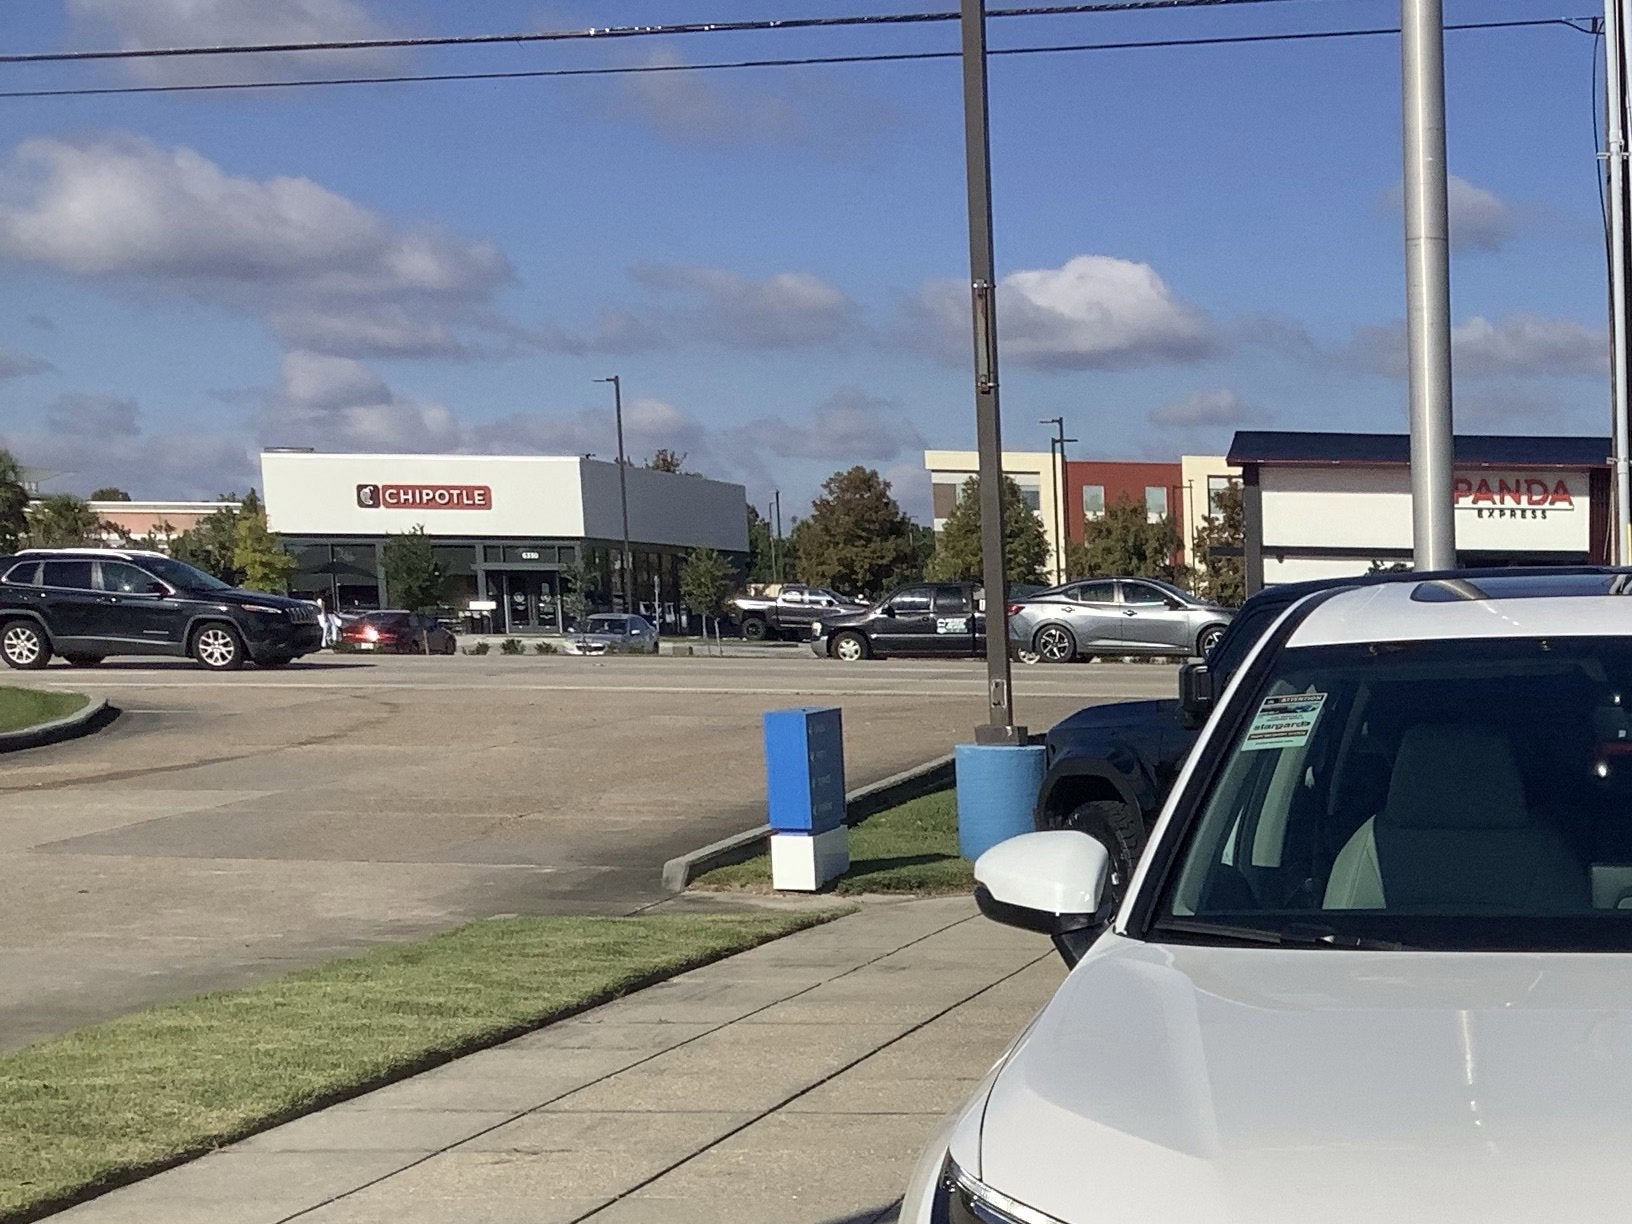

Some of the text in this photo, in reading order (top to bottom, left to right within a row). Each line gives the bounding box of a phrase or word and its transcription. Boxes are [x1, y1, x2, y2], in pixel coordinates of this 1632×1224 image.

[384, 488, 487, 506] CHIPOTLE
[1453, 478, 1575, 506] PANDA
[1477, 508, 1548, 520] EXPRESS
